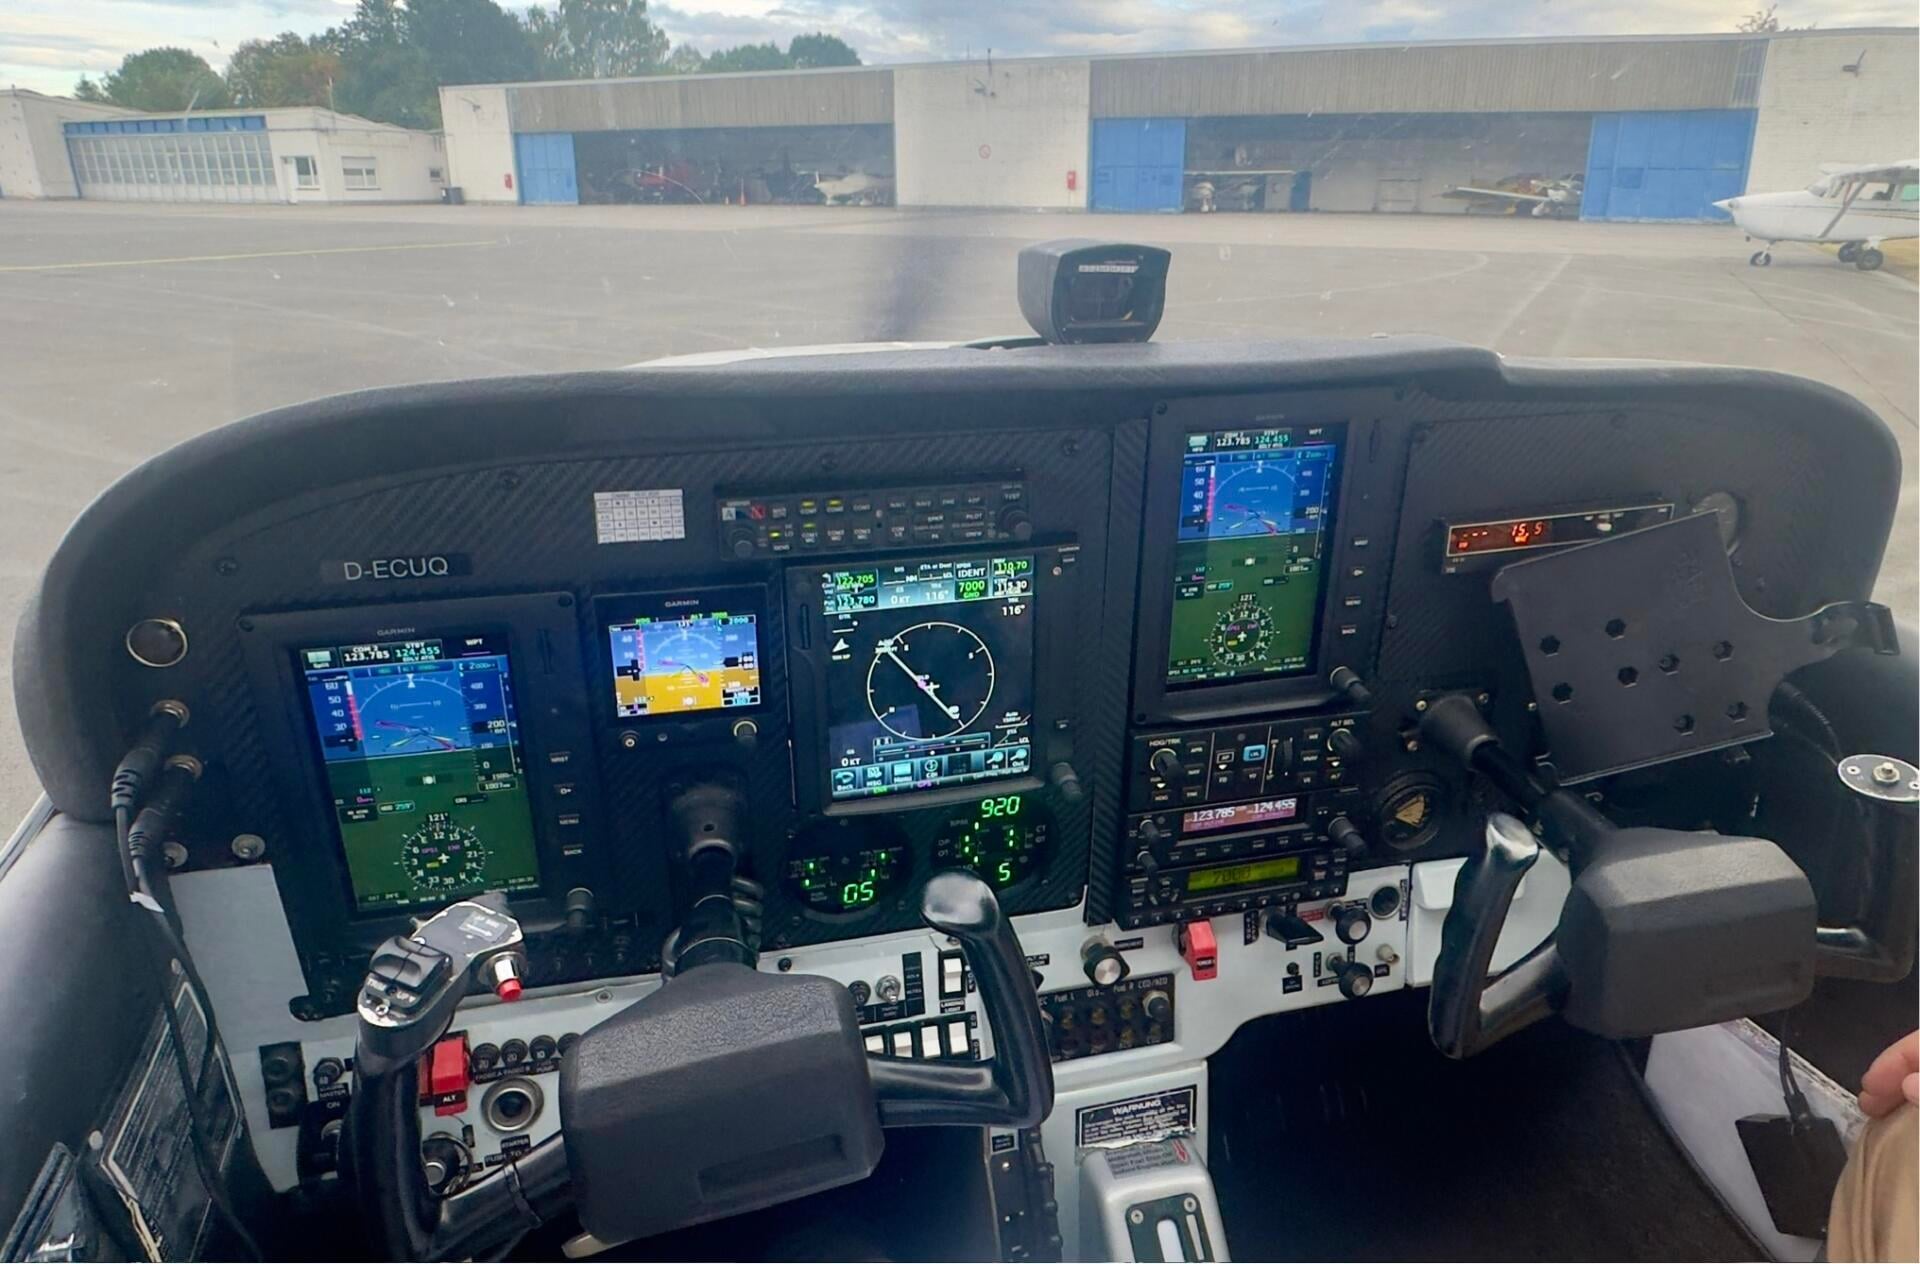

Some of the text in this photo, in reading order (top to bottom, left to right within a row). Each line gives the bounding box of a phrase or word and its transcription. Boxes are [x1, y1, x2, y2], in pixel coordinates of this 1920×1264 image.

[1216, 437, 1250, 447] 123.785
[1254, 434, 1288, 444] 124.455
[1194, 478, 1205, 486] 50
[1193, 491, 1204, 499] 40
[344, 556, 449, 581] D-ECUQ
[958, 568, 986, 578] IDENT
[958, 581, 985, 592] 7000
[665, 600, 699, 608] GARMIN
[1002, 605, 1025, 616] 116°
[377, 627, 415, 637] GARMIN
[465, 638, 483, 646] WPT
[344, 650, 390, 662] 123.785
[395, 646, 440, 658] 124.455
[328, 696, 341, 704] 50
[331, 709, 344, 718] 40
[487, 720, 505, 730] 200
[1330, 719, 1342, 727] ALT
[483, 761, 490, 769] 0
[981, 796, 1021, 818] 920
[1254, 798, 1297, 813] 124.455
[428, 813, 448, 822] 121°
[1192, 806, 1235, 822] 123.785
[434, 831, 445, 839] 12
[449, 832, 460, 841] 15
[999, 862, 1011, 881] 5
[443, 877, 454, 885] 30
[326, 1101, 341, 1109] ON
[1112, 1099, 1161, 1115] WARNUNG
